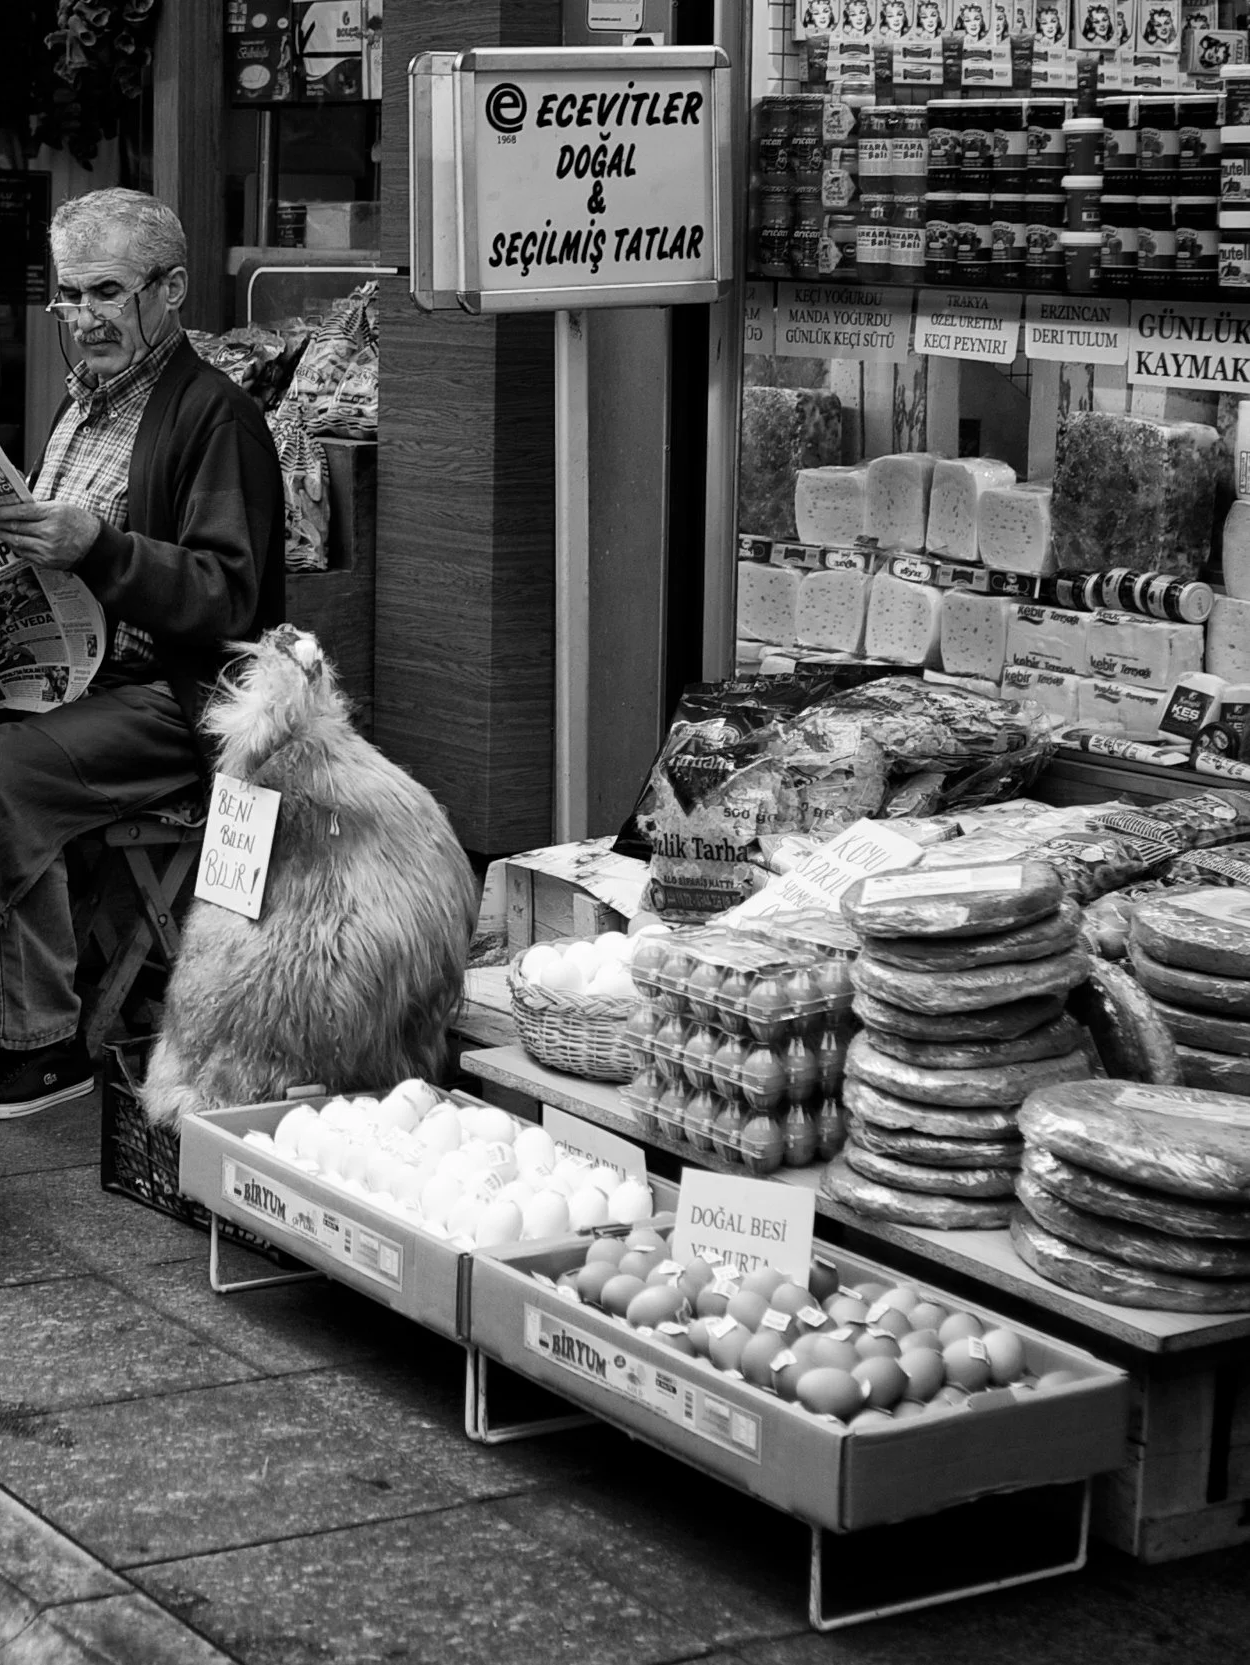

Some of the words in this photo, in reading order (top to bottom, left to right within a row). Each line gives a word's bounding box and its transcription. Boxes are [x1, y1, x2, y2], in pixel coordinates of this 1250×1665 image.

[536, 80, 704, 128] ECEVİTLER
[497, 134, 517, 144] 1968
[556, 131, 636, 179] DOĞAL
[587, 180, 606, 214] &
[489, 218, 606, 277] SEÇİLMİŞ
[614, 225, 704, 262] TATLAR
[795, 288, 822, 306] KEÇİ
[824, 288, 883, 306] YOĞURDU
[947, 294, 989, 309] TRAKYA
[1040, 304, 1112, 322] ERZINCAN
[789, 309, 830, 324] MANDA
[834, 309, 893, 327] YOĞURDU
[1138, 308, 1250, 344] GÜNLÜK
[786, 328, 832, 345] GÜNLÜK
[834, 330, 861, 349] KEÇİ
[863, 332, 895, 348] SÜTÜ
[1033, 328, 1064, 344] DERI
[1067, 330, 1119, 348] TULUM
[1135, 350, 1250, 383] KAYMAK
[218, 788, 257, 823] BENİ
[243, 1178, 286, 1221] BİRYUM
[690, 1205, 746, 1234] DOĞAL
[750, 1216, 787, 1242] BESİ
[551, 1329, 608, 1379] BİRYUM
